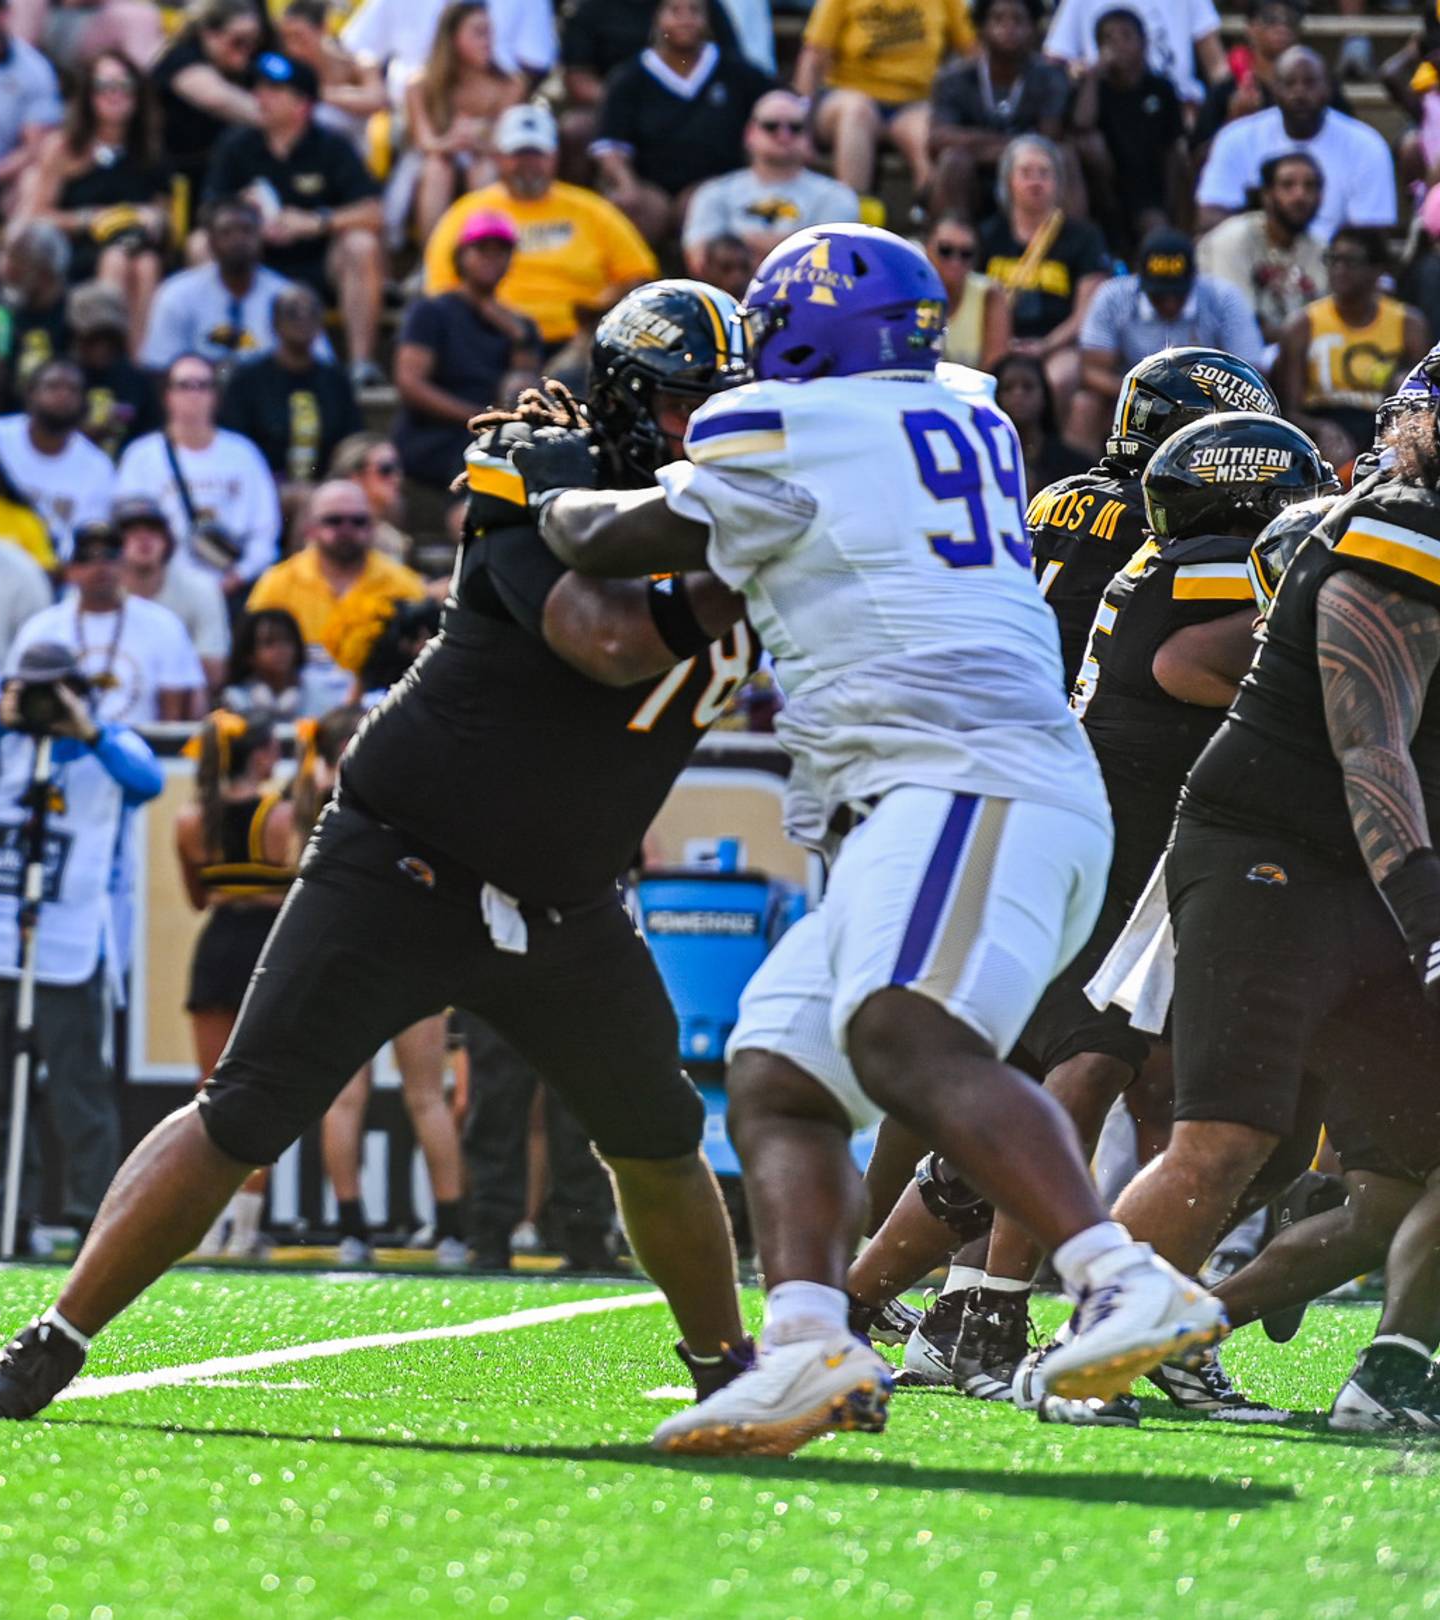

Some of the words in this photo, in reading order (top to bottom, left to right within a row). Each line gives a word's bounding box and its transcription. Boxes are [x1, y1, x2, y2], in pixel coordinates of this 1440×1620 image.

[1190, 364, 1276, 415] SOUTHERN
[1216, 383, 1253, 412] MISS
[1120, 441, 1139, 455] TOP
[1190, 447, 1293, 468] SOUTHERN
[900, 405, 1032, 569] 99
[1216, 465, 1259, 482] MISS
[1089, 500, 1127, 541] III
